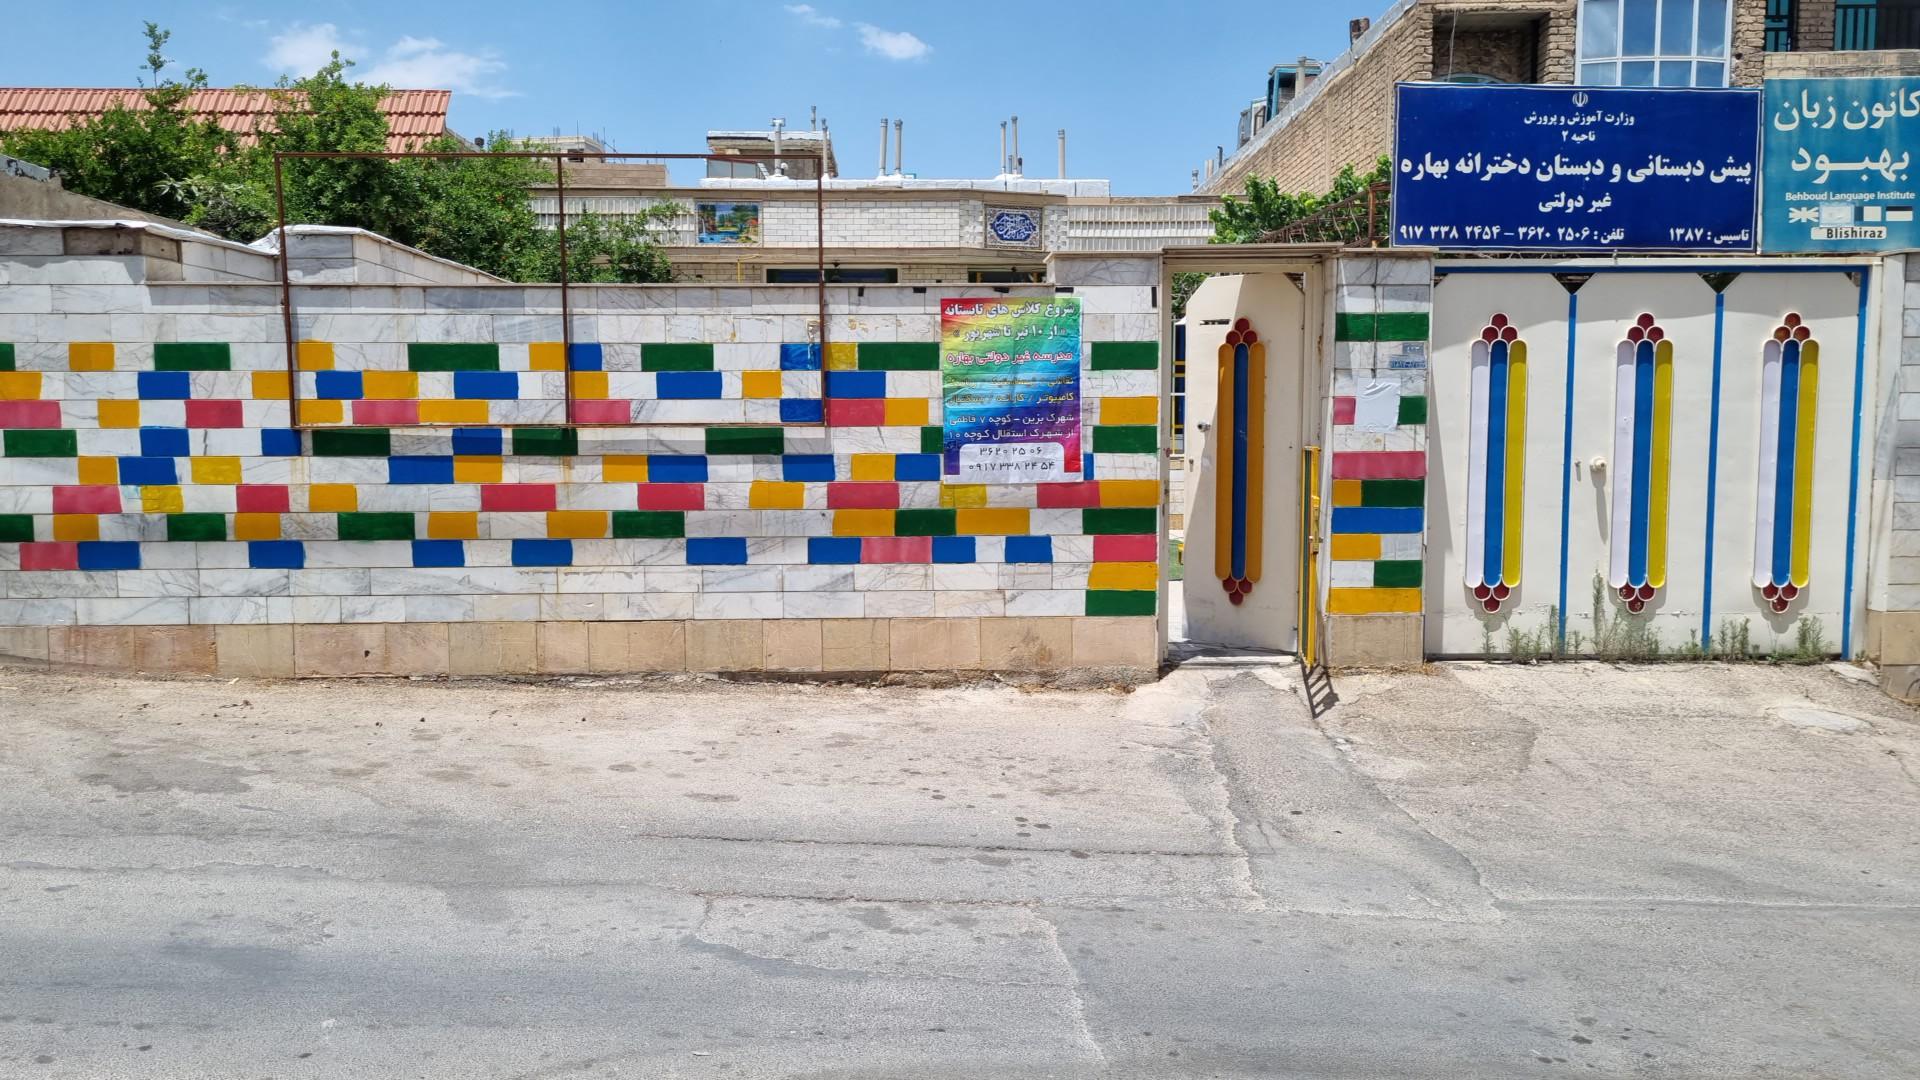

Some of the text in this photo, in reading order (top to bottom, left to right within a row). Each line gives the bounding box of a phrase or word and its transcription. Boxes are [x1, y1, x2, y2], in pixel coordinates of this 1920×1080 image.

[1773, 88, 1837, 131] زبان
[1523, 110, 1635, 126] وزارت آموزش و پرورش
[1561, 130, 1596, 144] ناحیه ۲
[1400, 151, 1752, 185] پیش دبستانی و دبستان دخترانه بهاره
[1791, 147, 1910, 184] بهبود
[1538, 191, 1612, 213] غیر دولتی
[1785, 191, 1916, 202] Behboud Language Institute
[1400, 224, 1424, 240] ۹۱۷
[1430, 224, 1459, 240] ۳۳۸
[1465, 224, 1501, 240] ۲۴۵۴
[1517, 226, 1551, 241] ۳۶۲۰
[1557, 226, 1591, 241] ۲۵۰۶
[1669, 227, 1704, 242] ۱۳۸۷
[1826, 228, 1883, 239] Blishiraz
[944, 302, 1075, 319] شروع کلاس های تابستانه
[1047, 325, 1058, 340] از
[946, 350, 1073, 366] مدرسه غیر دولتی بهاره
[1036, 392, 1075, 404] کامپیوتر
[988, 414, 1011, 426] کوچه
[1046, 413, 1075, 425] شهرک
[963, 429, 990, 441] کوچه
[992, 428, 1027, 440] استقلال
